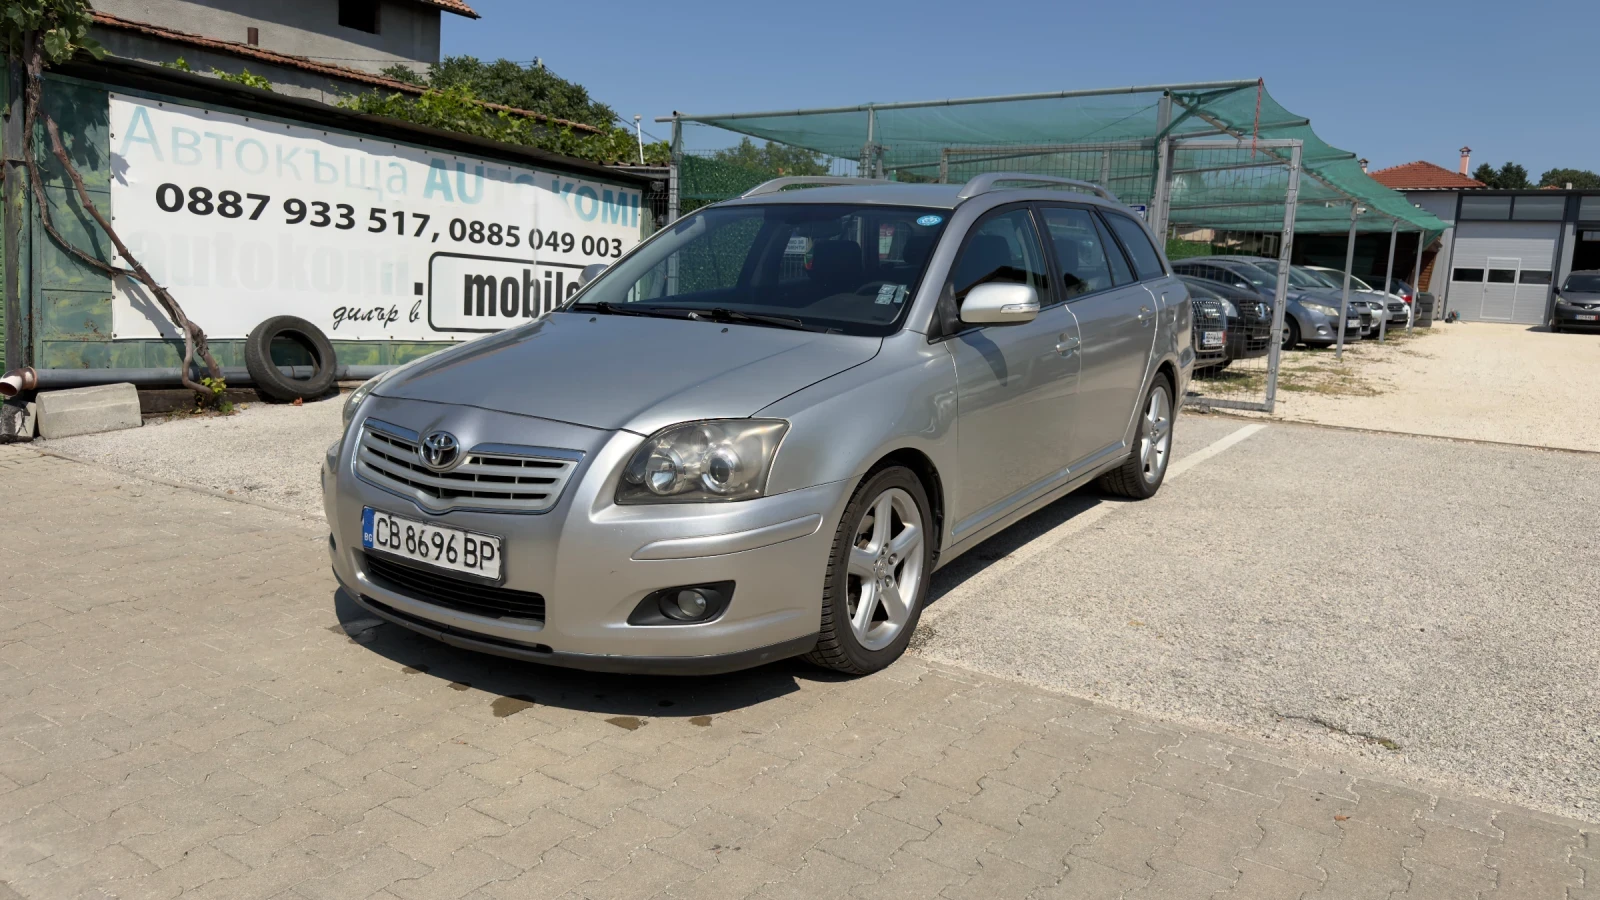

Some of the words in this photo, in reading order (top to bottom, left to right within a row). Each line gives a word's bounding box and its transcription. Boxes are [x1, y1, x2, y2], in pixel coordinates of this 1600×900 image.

[119, 106, 408, 201] Автокъща
[155, 182, 271, 221] 0887
[283, 198, 356, 230] 933
[367, 207, 440, 243] 517,
[449, 218, 520, 248] 0885
[528, 228, 575, 253] 049
[581, 235, 623, 259] 003
[551, 179, 639, 228] KOMI
[364, 533, 373, 543] BG
[405, 525, 458, 564] 8696
